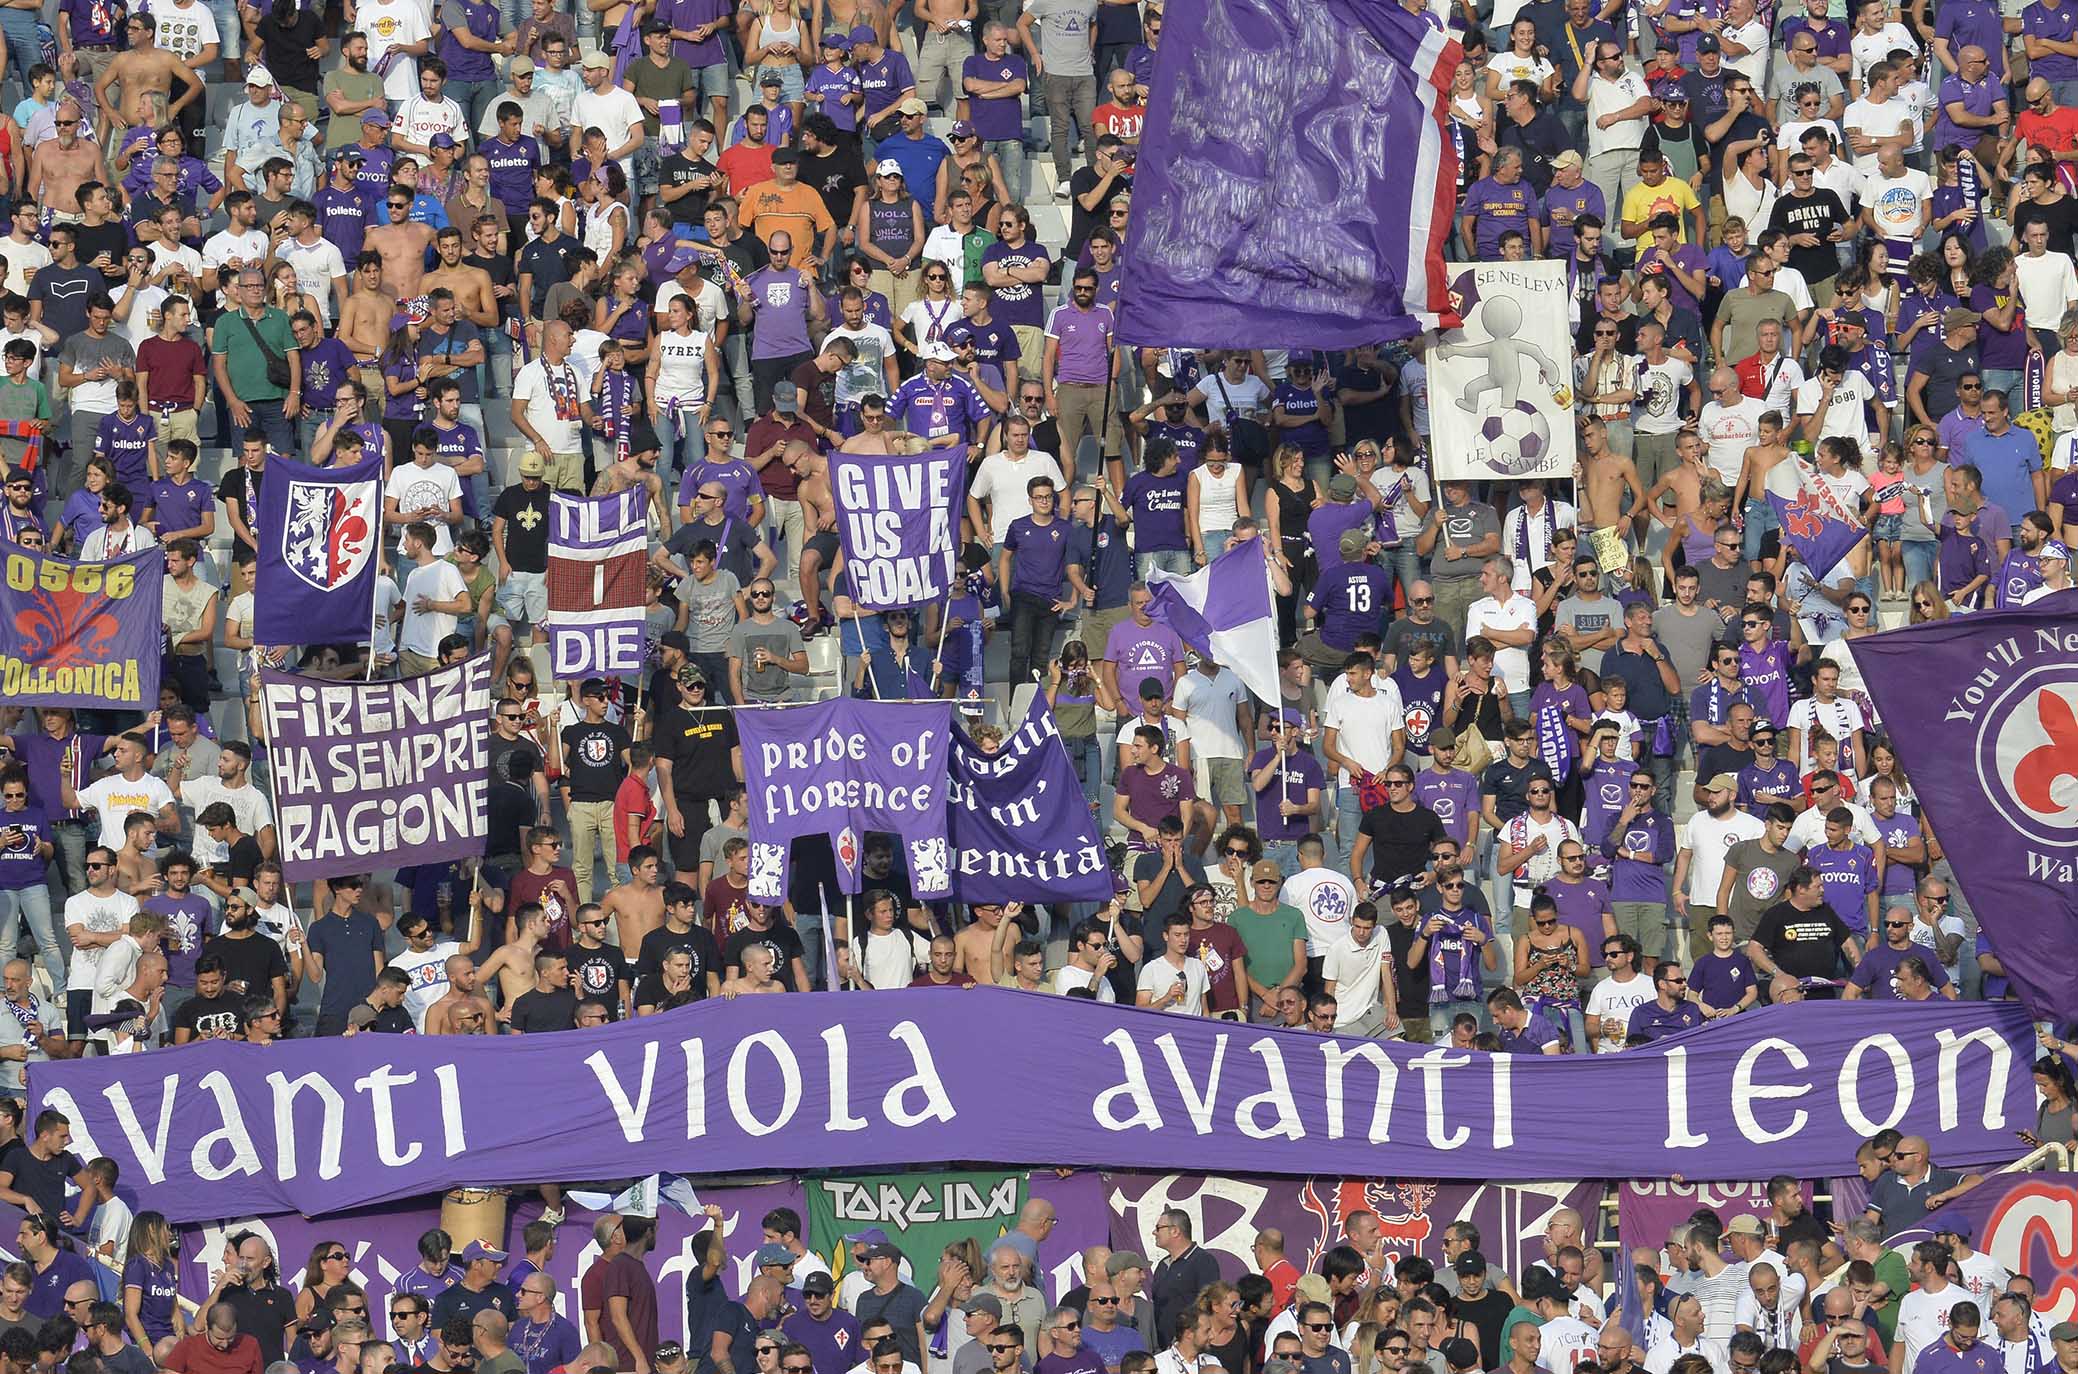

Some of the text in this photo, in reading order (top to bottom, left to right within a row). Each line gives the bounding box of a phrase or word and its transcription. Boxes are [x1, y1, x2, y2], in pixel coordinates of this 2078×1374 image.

[862, 79, 887, 89] lletto
[414, 121, 453, 134] TOYOTA
[491, 157, 529, 169] folletto
[356, 171, 388, 183] OYOT
[673, 170, 687, 181] SAN
[326, 205, 363, 217] folletto
[874, 210, 909, 218] VIOLA
[1787, 204, 1831, 224] BRKLYN
[1803, 219, 1820, 230] NYC
[1477, 270, 1566, 293] SE NE LEVA
[994, 286, 1034, 302] AUTONOMO
[660, 344, 703, 357] PYREX
[2032, 368, 2041, 408] FIORENT
[915, 396, 954, 405] Nintdo
[1286, 399, 1319, 409] follett
[436, 444, 465, 453] letto
[1465, 447, 1560, 475] LE GAMBE
[838, 460, 950, 510] GIVE
[550, 483, 646, 543] TILL
[1148, 499, 1182, 512] Capitan
[847, 507, 953, 560] US A
[6, 553, 136, 600] 0566
[593, 564, 605, 606] I
[1346, 584, 1371, 613] 13
[556, 626, 640, 674] DIE
[1743, 670, 1781, 686] OYOTA
[1943, 636, 2024, 725] You'll
[272, 718, 489, 799] HA SEMPRE
[891, 730, 934, 771] of
[959, 836, 1105, 882] entità
[2026, 850, 2078, 883] Wa
[1820, 871, 1861, 885] TOYOTA
[1664, 1026, 2045, 1148] leon
[822, 1176, 1019, 1231] TORCIDA
